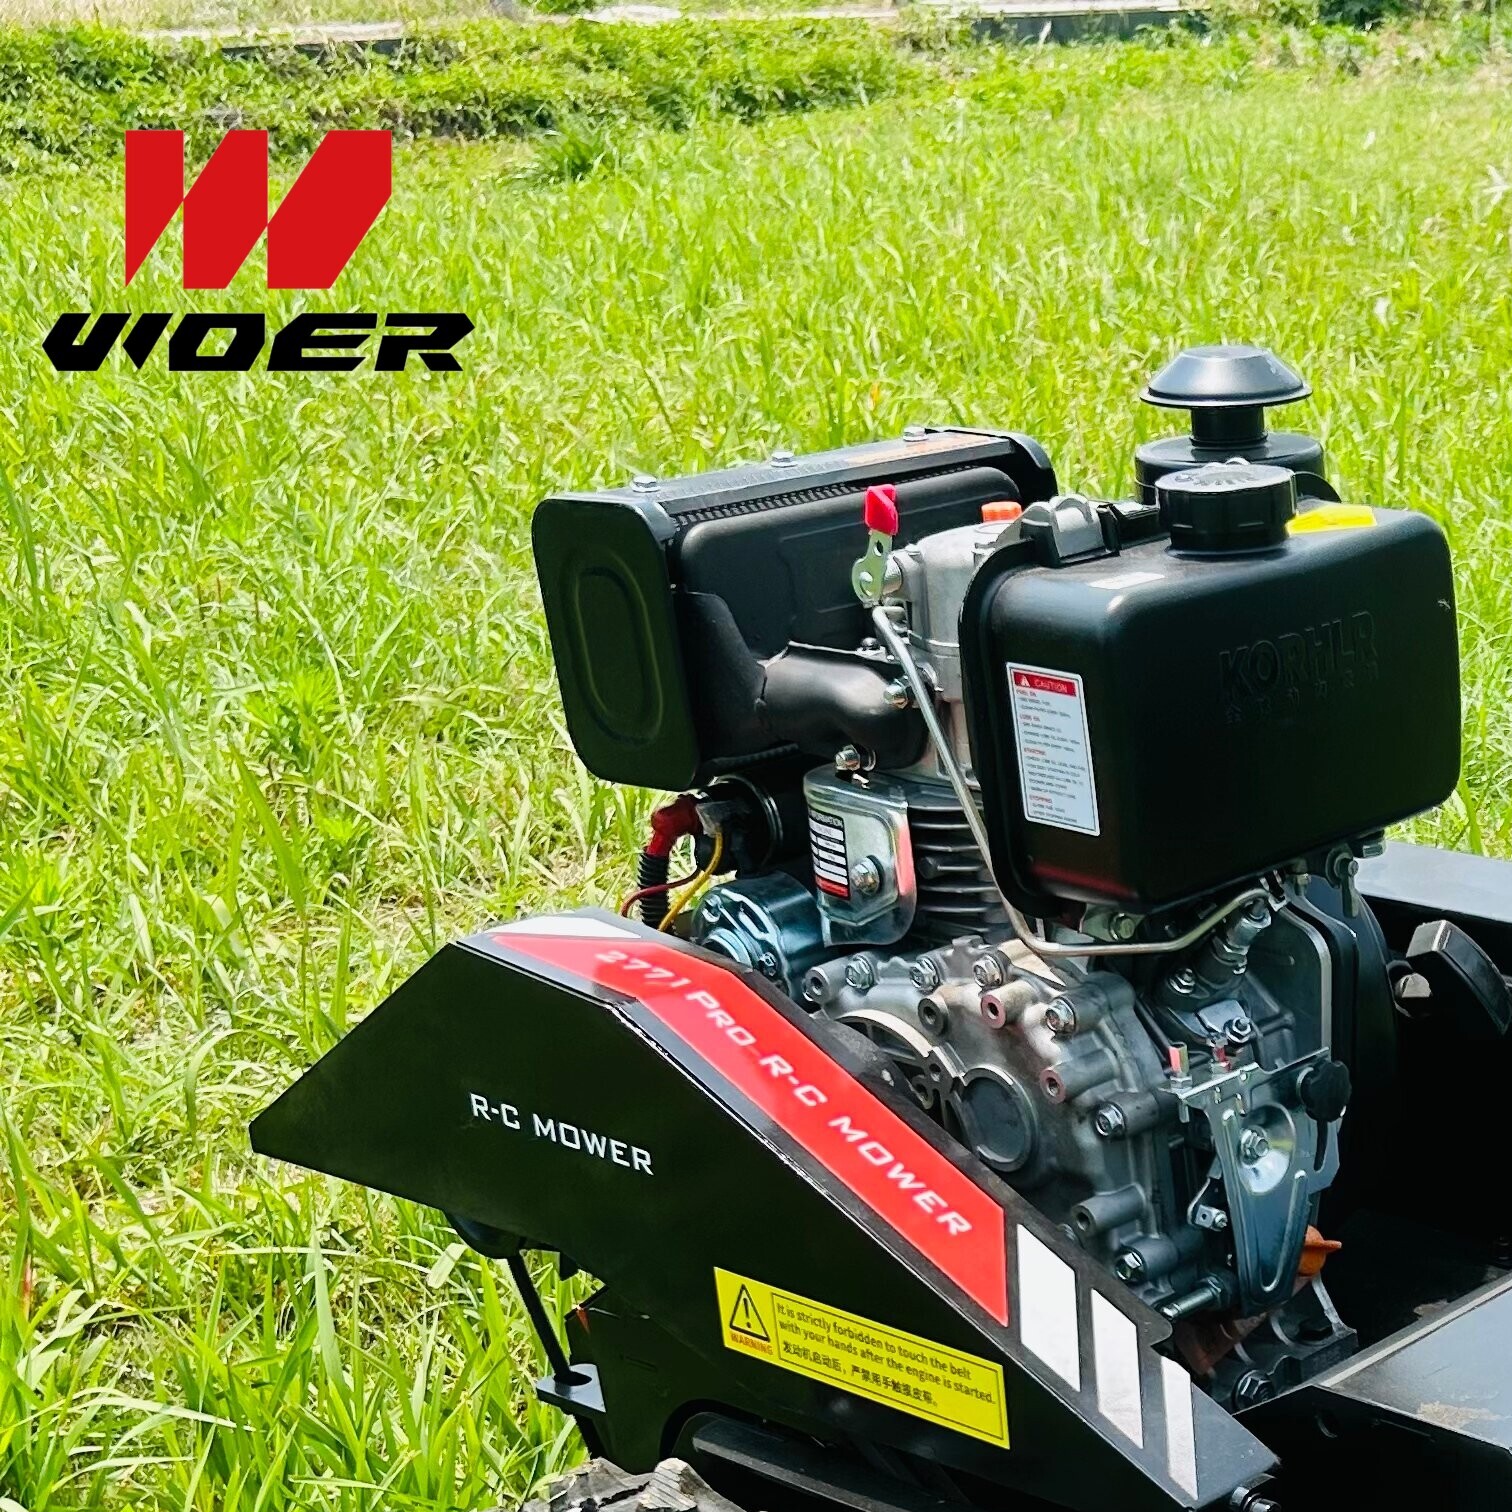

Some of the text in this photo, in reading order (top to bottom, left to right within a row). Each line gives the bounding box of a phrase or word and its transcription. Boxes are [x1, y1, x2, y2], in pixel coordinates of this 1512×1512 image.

[1033, 679, 1068, 694] CAUTION
[470, 1092, 655, 1176] R-C MOWER
[759, 1054, 828, 1108] R-C
[828, 1115, 973, 1237] MOWER
[731, 1332, 773, 1355] WARNING
[780, 1320, 801, 1333] with
[803, 1328, 827, 1344] your
[827, 1335, 858, 1356] hands
[860, 1348, 885, 1364] after
[886, 1356, 904, 1373] the
[905, 1364, 942, 1386] engine
[943, 1374, 952, 1390] is
[797, 1310, 831, 1333] strictly
[832, 1322, 883, 1350] forbidden
[884, 1341, 896, 1354] to
[898, 1345, 928, 1365] touch
[930, 1357, 948, 1373] the
[949, 1362, 972, 1380] belt
